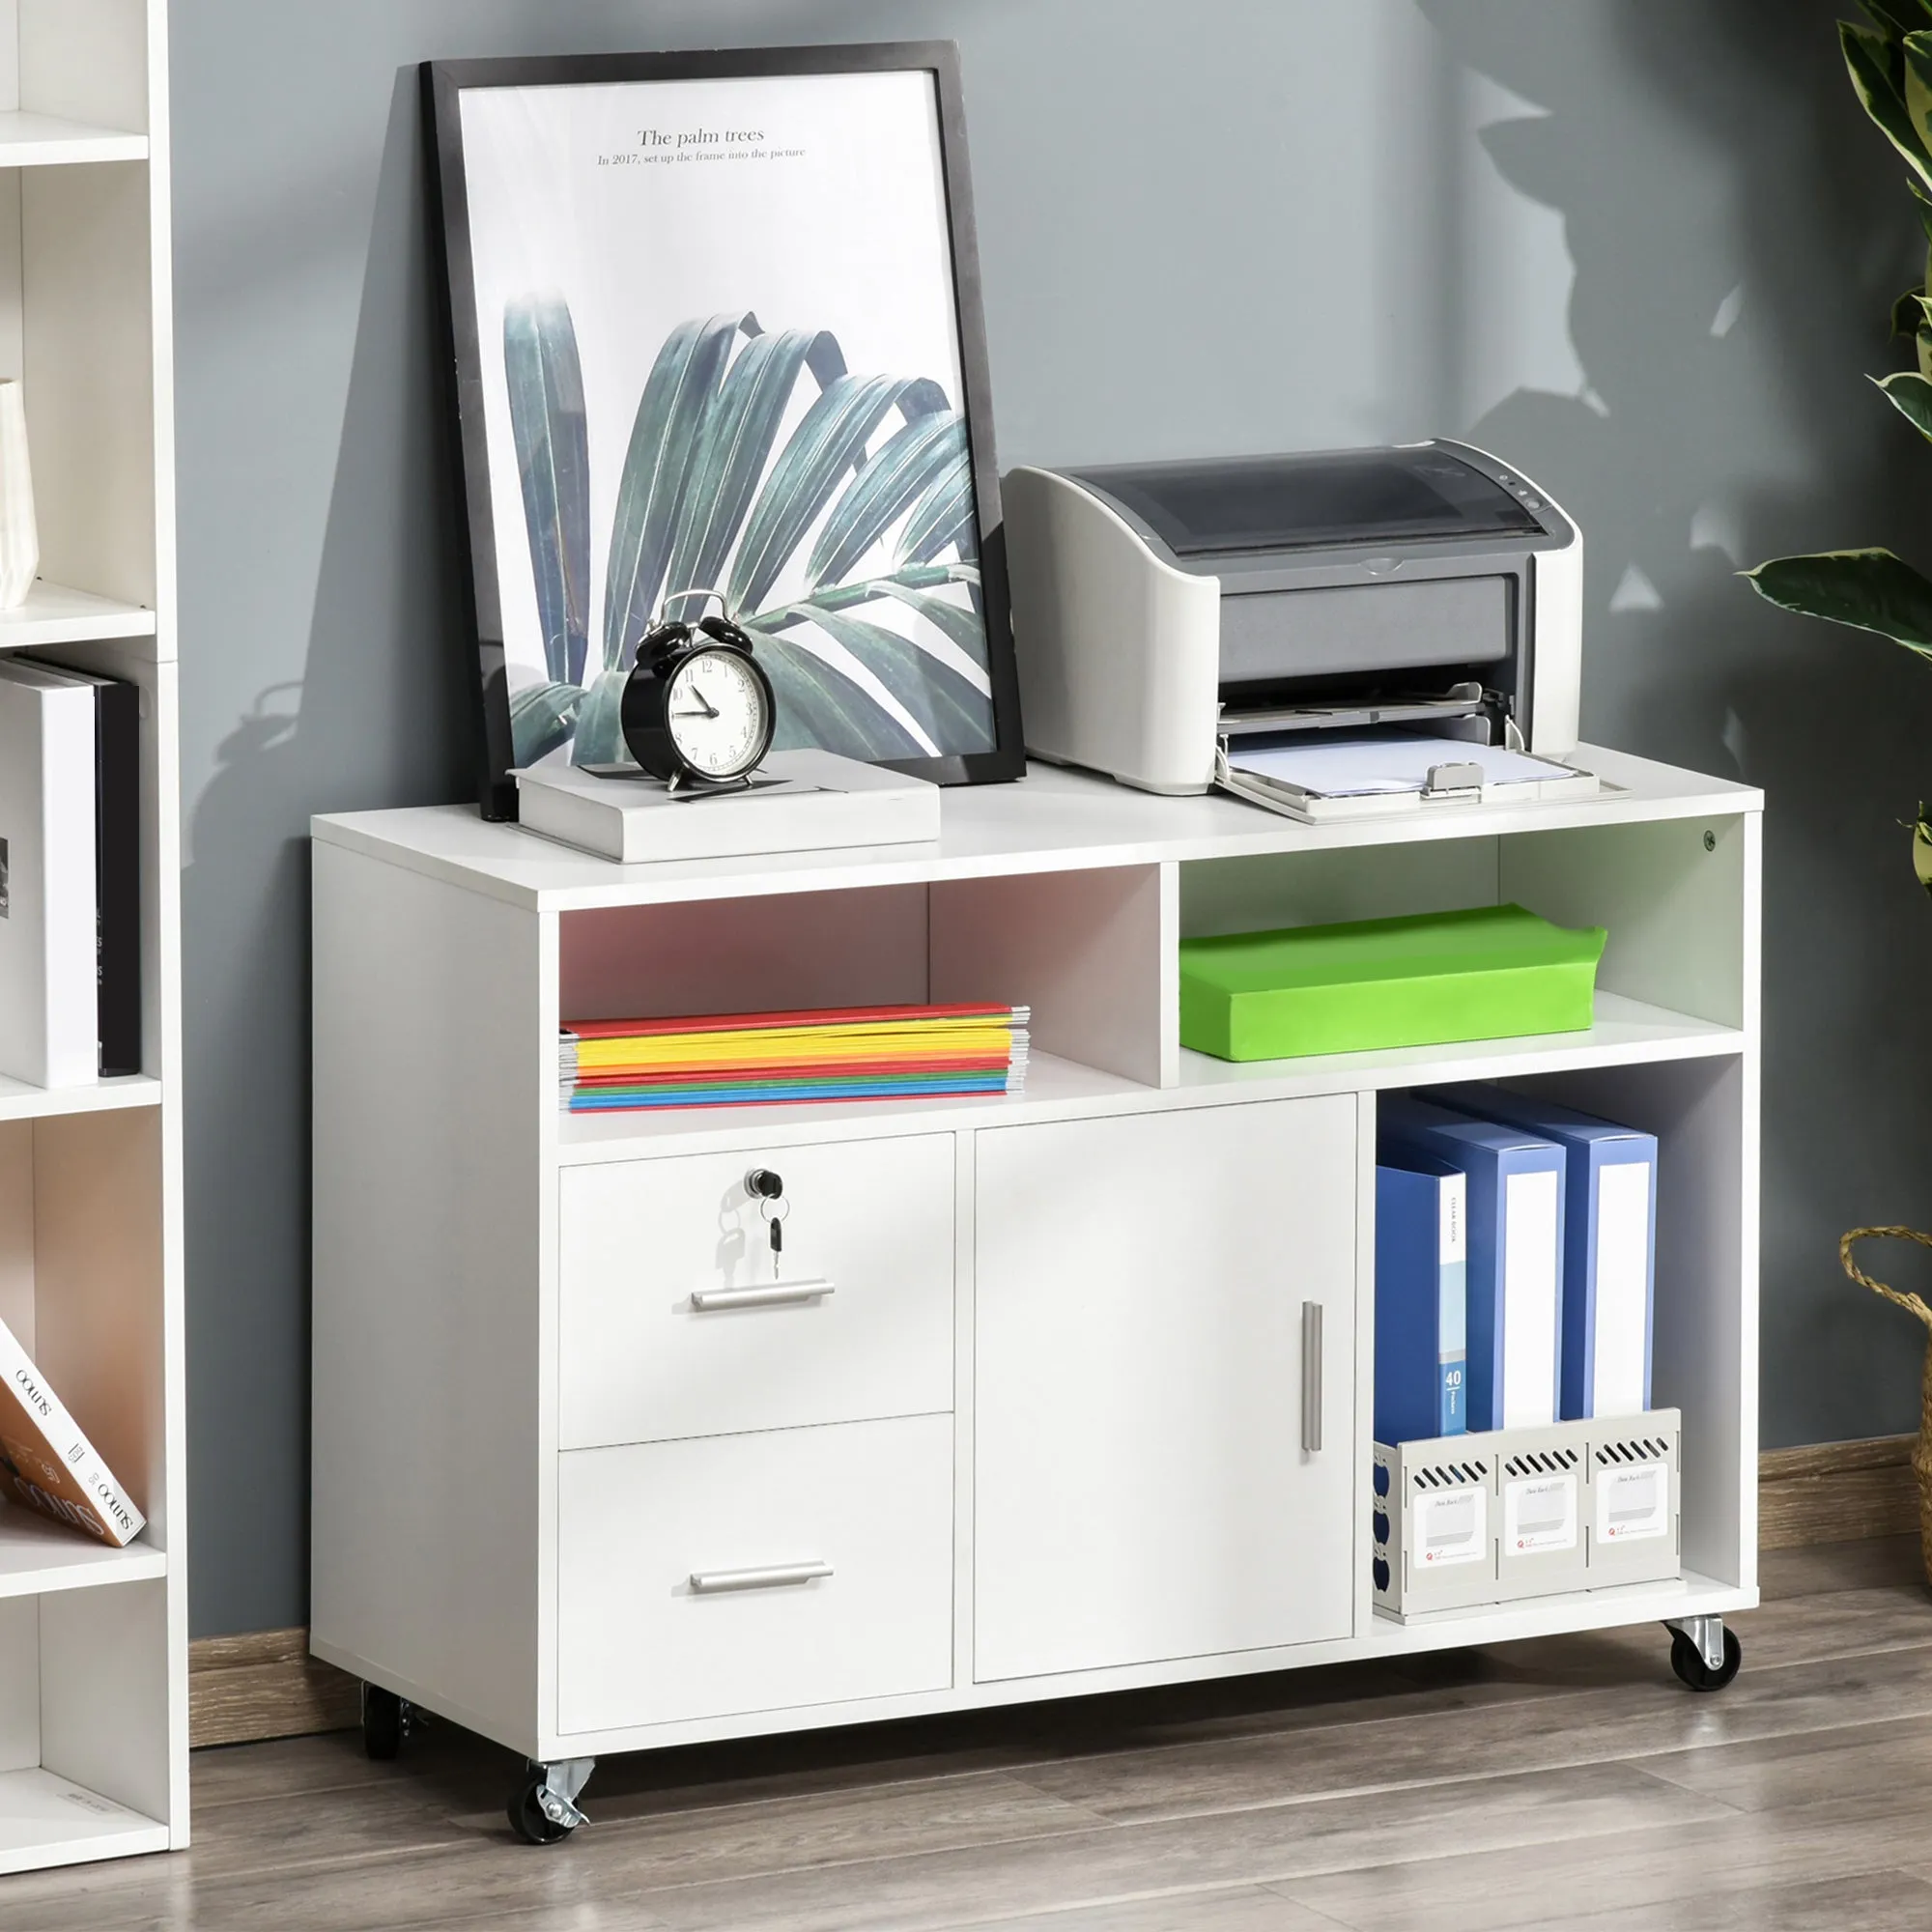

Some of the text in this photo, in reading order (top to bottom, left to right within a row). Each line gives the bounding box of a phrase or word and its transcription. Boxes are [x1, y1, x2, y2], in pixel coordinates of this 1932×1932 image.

[636, 128, 765, 148] The palm trees
[597, 147, 806, 166] In 2017, set up the frame into the picture
[701, 659, 713, 673] 12
[684, 668, 694, 683] 11
[737, 679, 746, 693] 2
[672, 687, 683, 701] 10
[691, 747, 698, 761] 7
[709, 753, 718, 766] 6
[1445, 1370, 1462, 1386] 40
